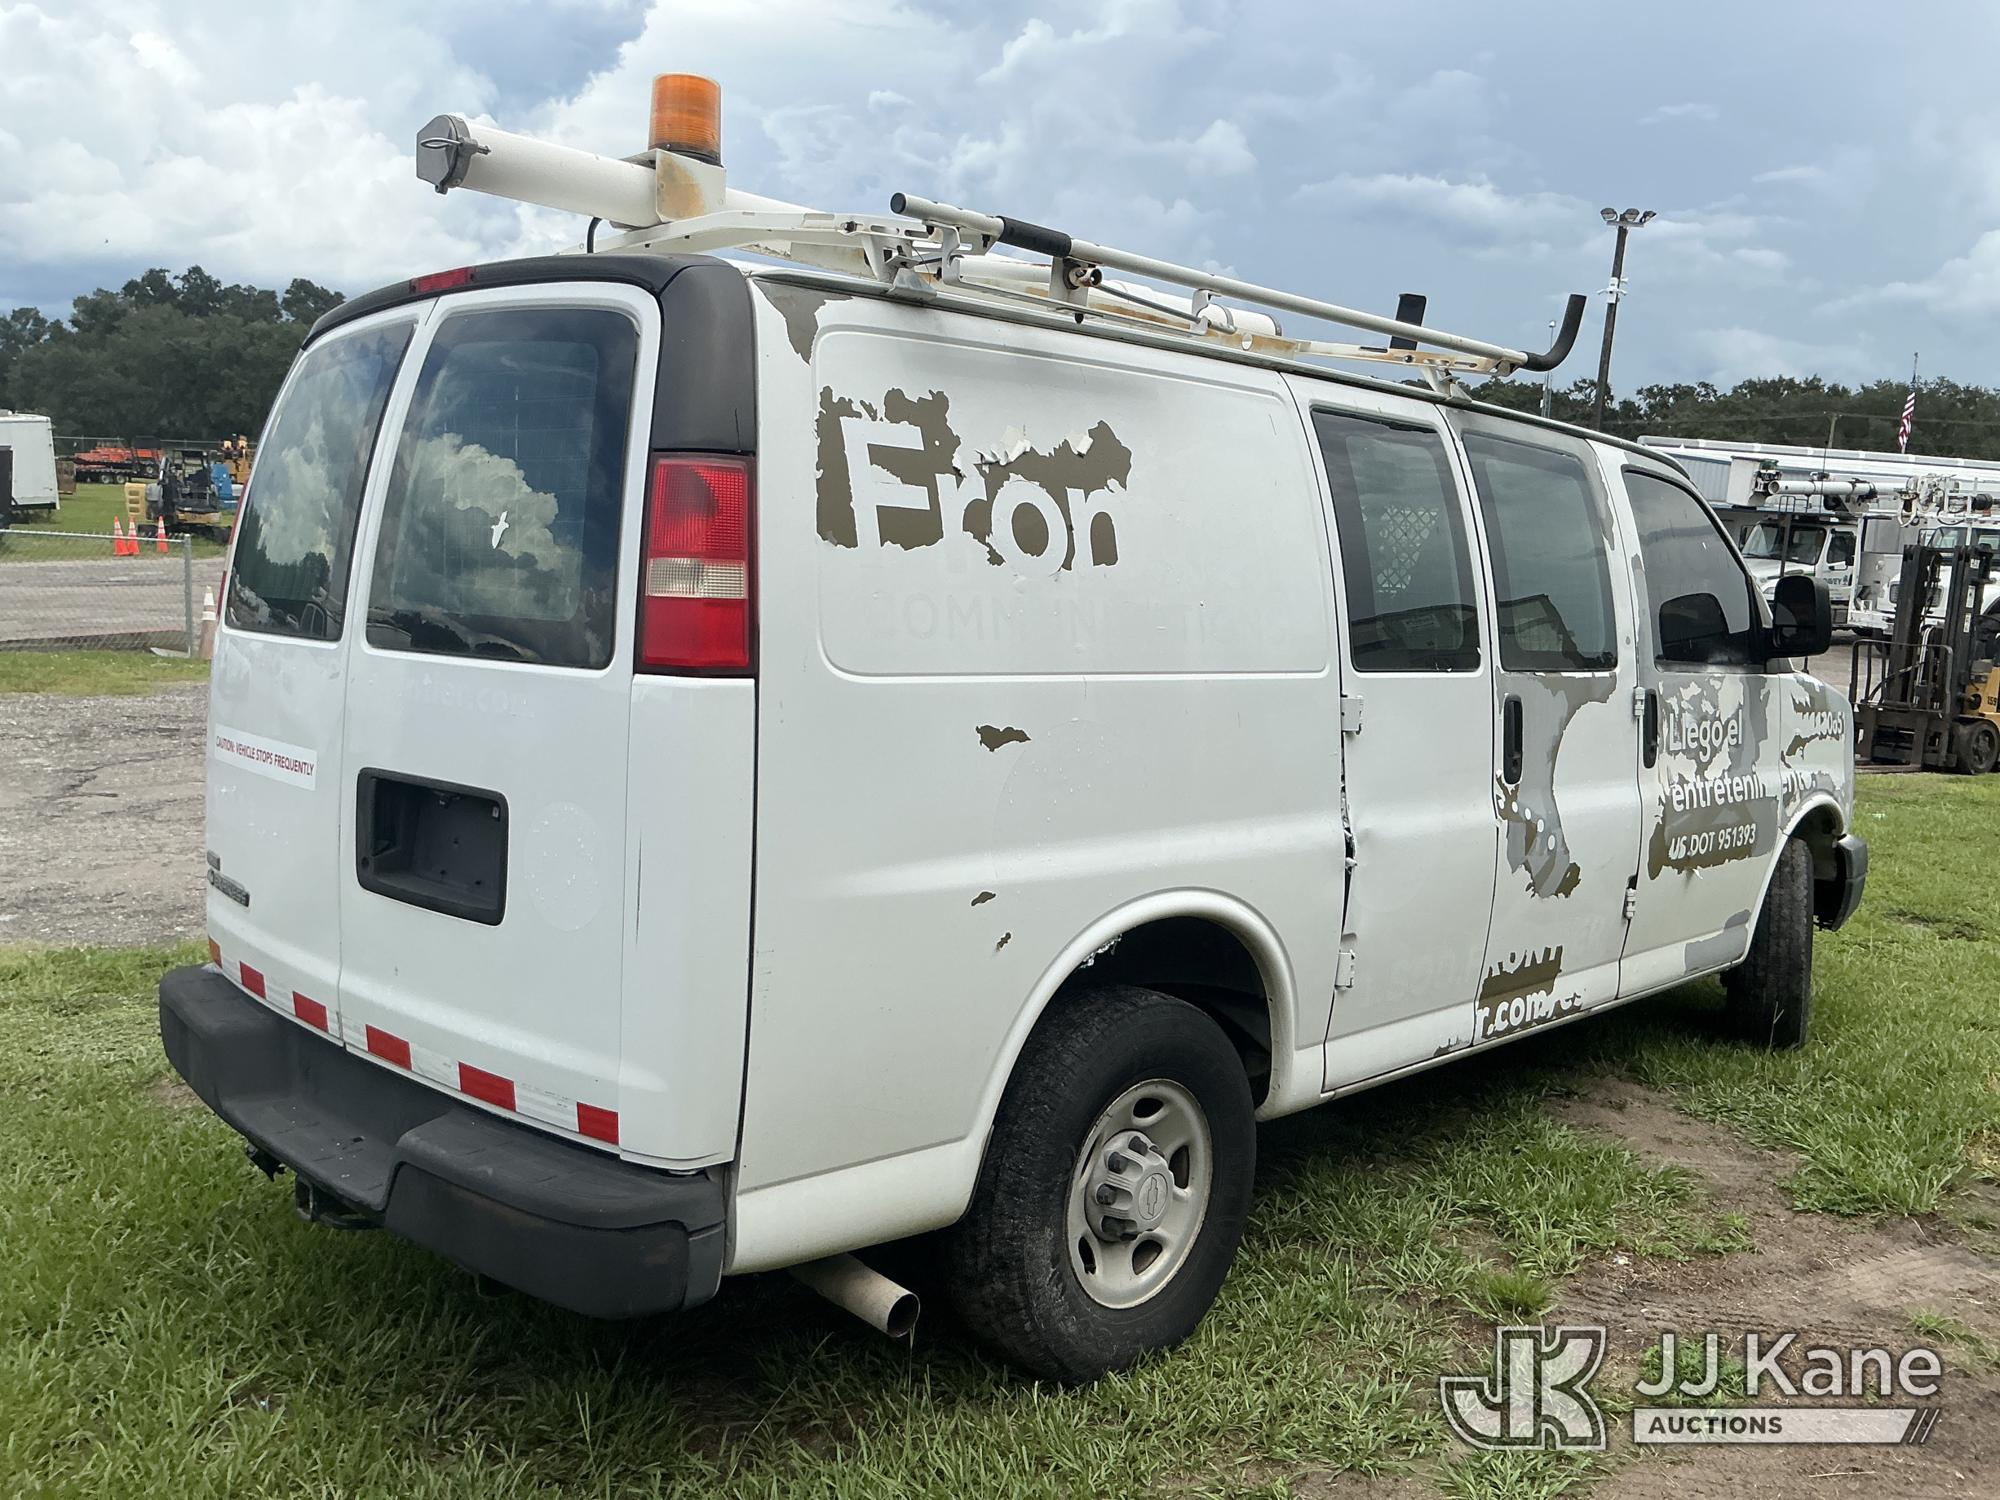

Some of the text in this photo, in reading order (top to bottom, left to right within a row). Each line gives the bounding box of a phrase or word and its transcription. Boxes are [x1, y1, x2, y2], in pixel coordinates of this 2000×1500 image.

[1727, 709, 1743, 745] el
[236, 742, 256, 761] VEHICLE
[256, 748, 273, 766] STOPS
[274, 753, 315, 776] FREQUENTLY
[1718, 823, 1757, 850] 951393
